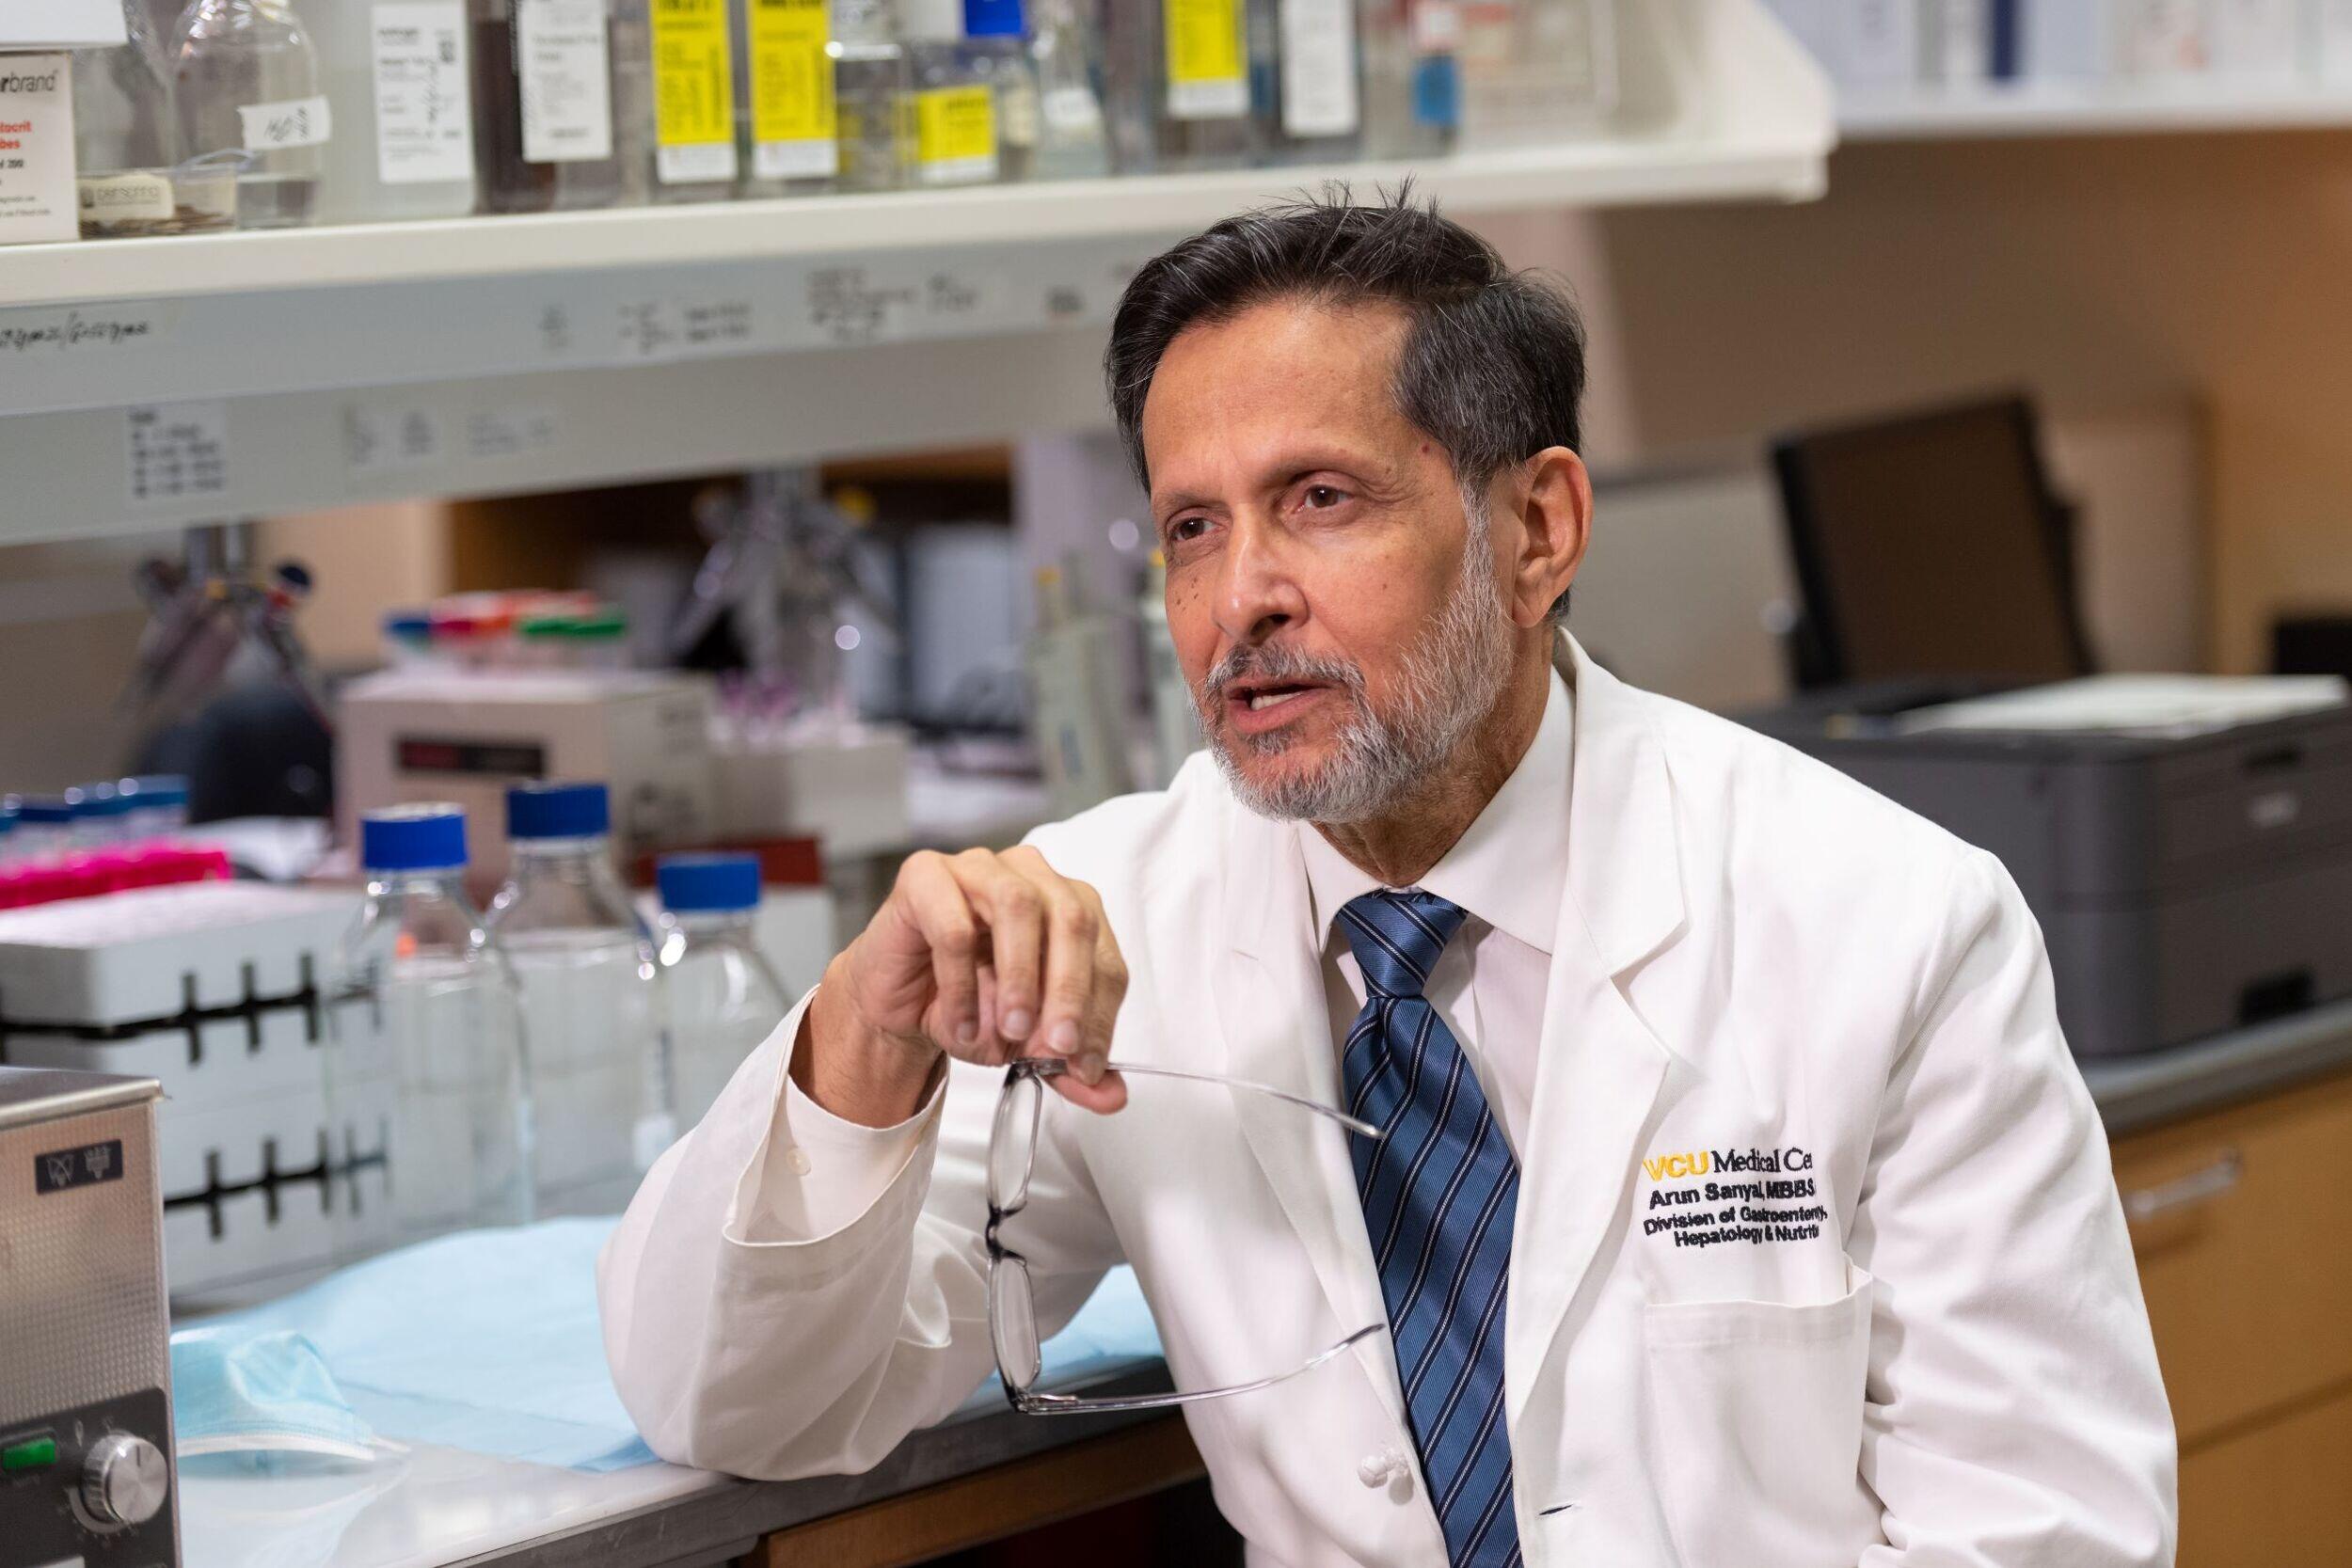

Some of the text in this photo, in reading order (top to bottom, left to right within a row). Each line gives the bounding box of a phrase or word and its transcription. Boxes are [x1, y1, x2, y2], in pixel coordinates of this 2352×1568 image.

[1643, 1147, 1813, 1182] VCU Medical Ce
[1648, 1189, 1701, 1211] Arun
[1765, 1178, 1816, 1199] MBBS
[1643, 1211, 1716, 1237] Division
[1718, 1205, 1736, 1224] of
[1673, 1225, 1764, 1248] Hepatology
[1764, 1224, 1774, 1241] &
